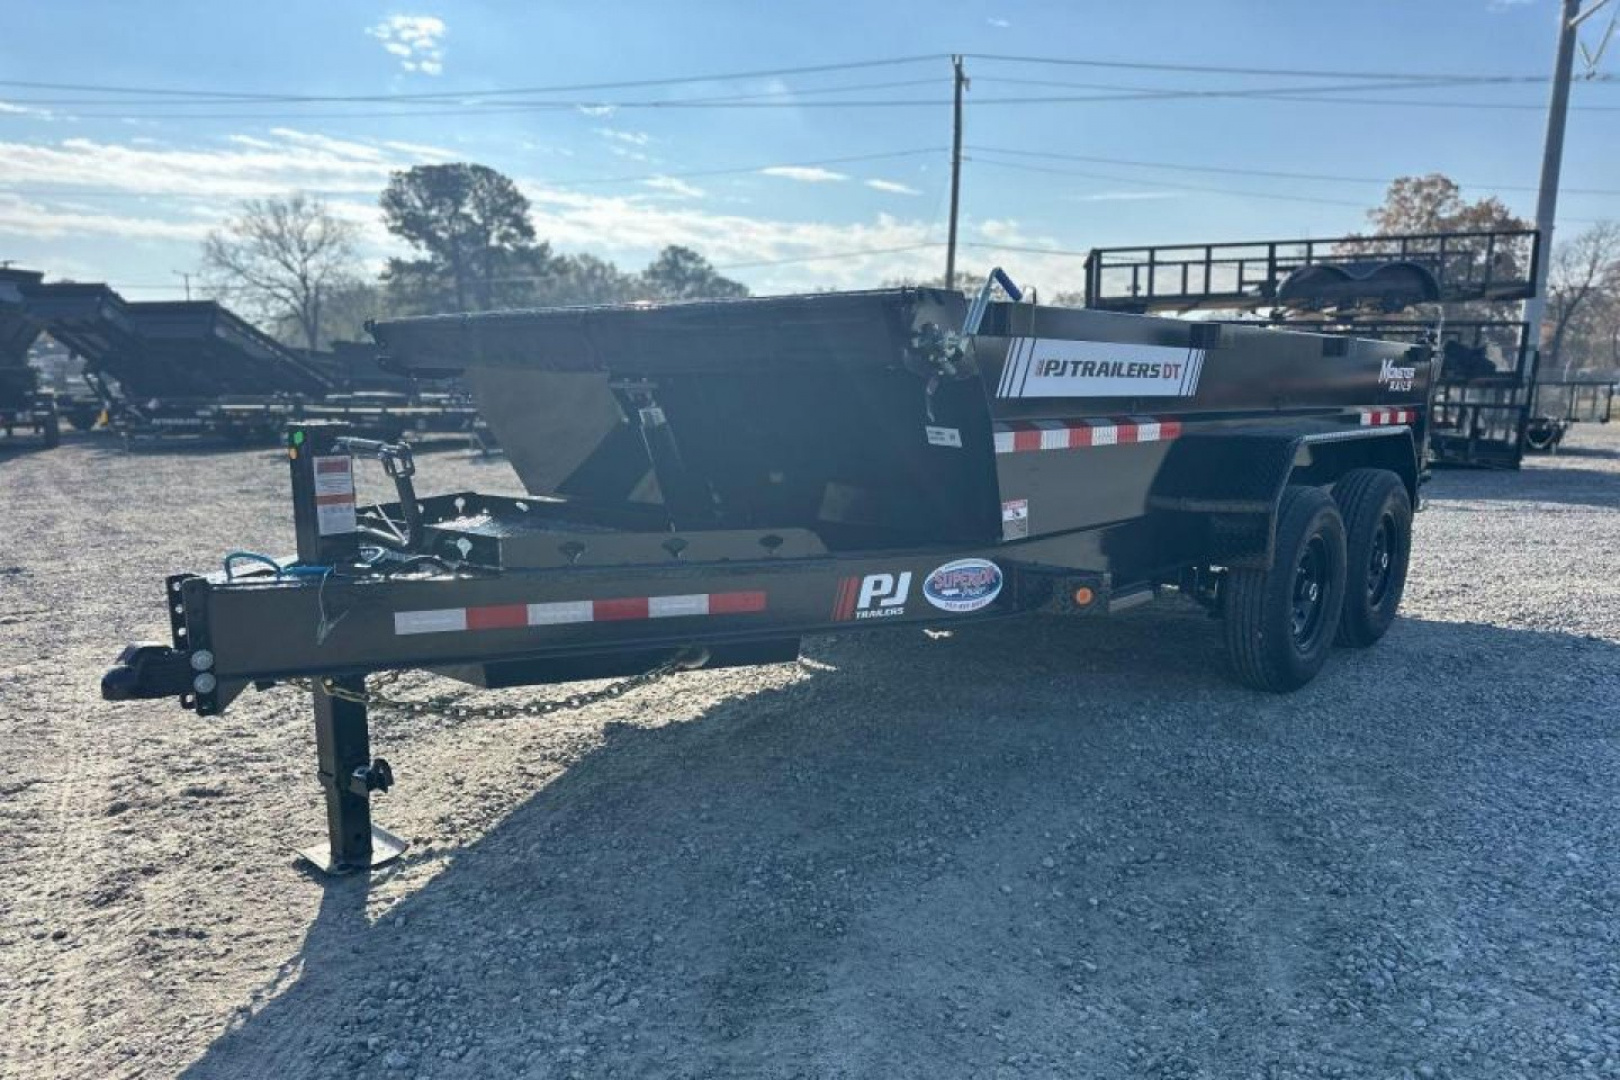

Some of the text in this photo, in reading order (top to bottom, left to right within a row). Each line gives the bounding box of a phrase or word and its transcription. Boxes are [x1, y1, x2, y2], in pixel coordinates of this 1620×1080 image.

[1044, 359, 1182, 380] PJ TRAILERS DT
[857, 571, 912, 609] PJ
[855, 607, 906, 619] TRAILERS
